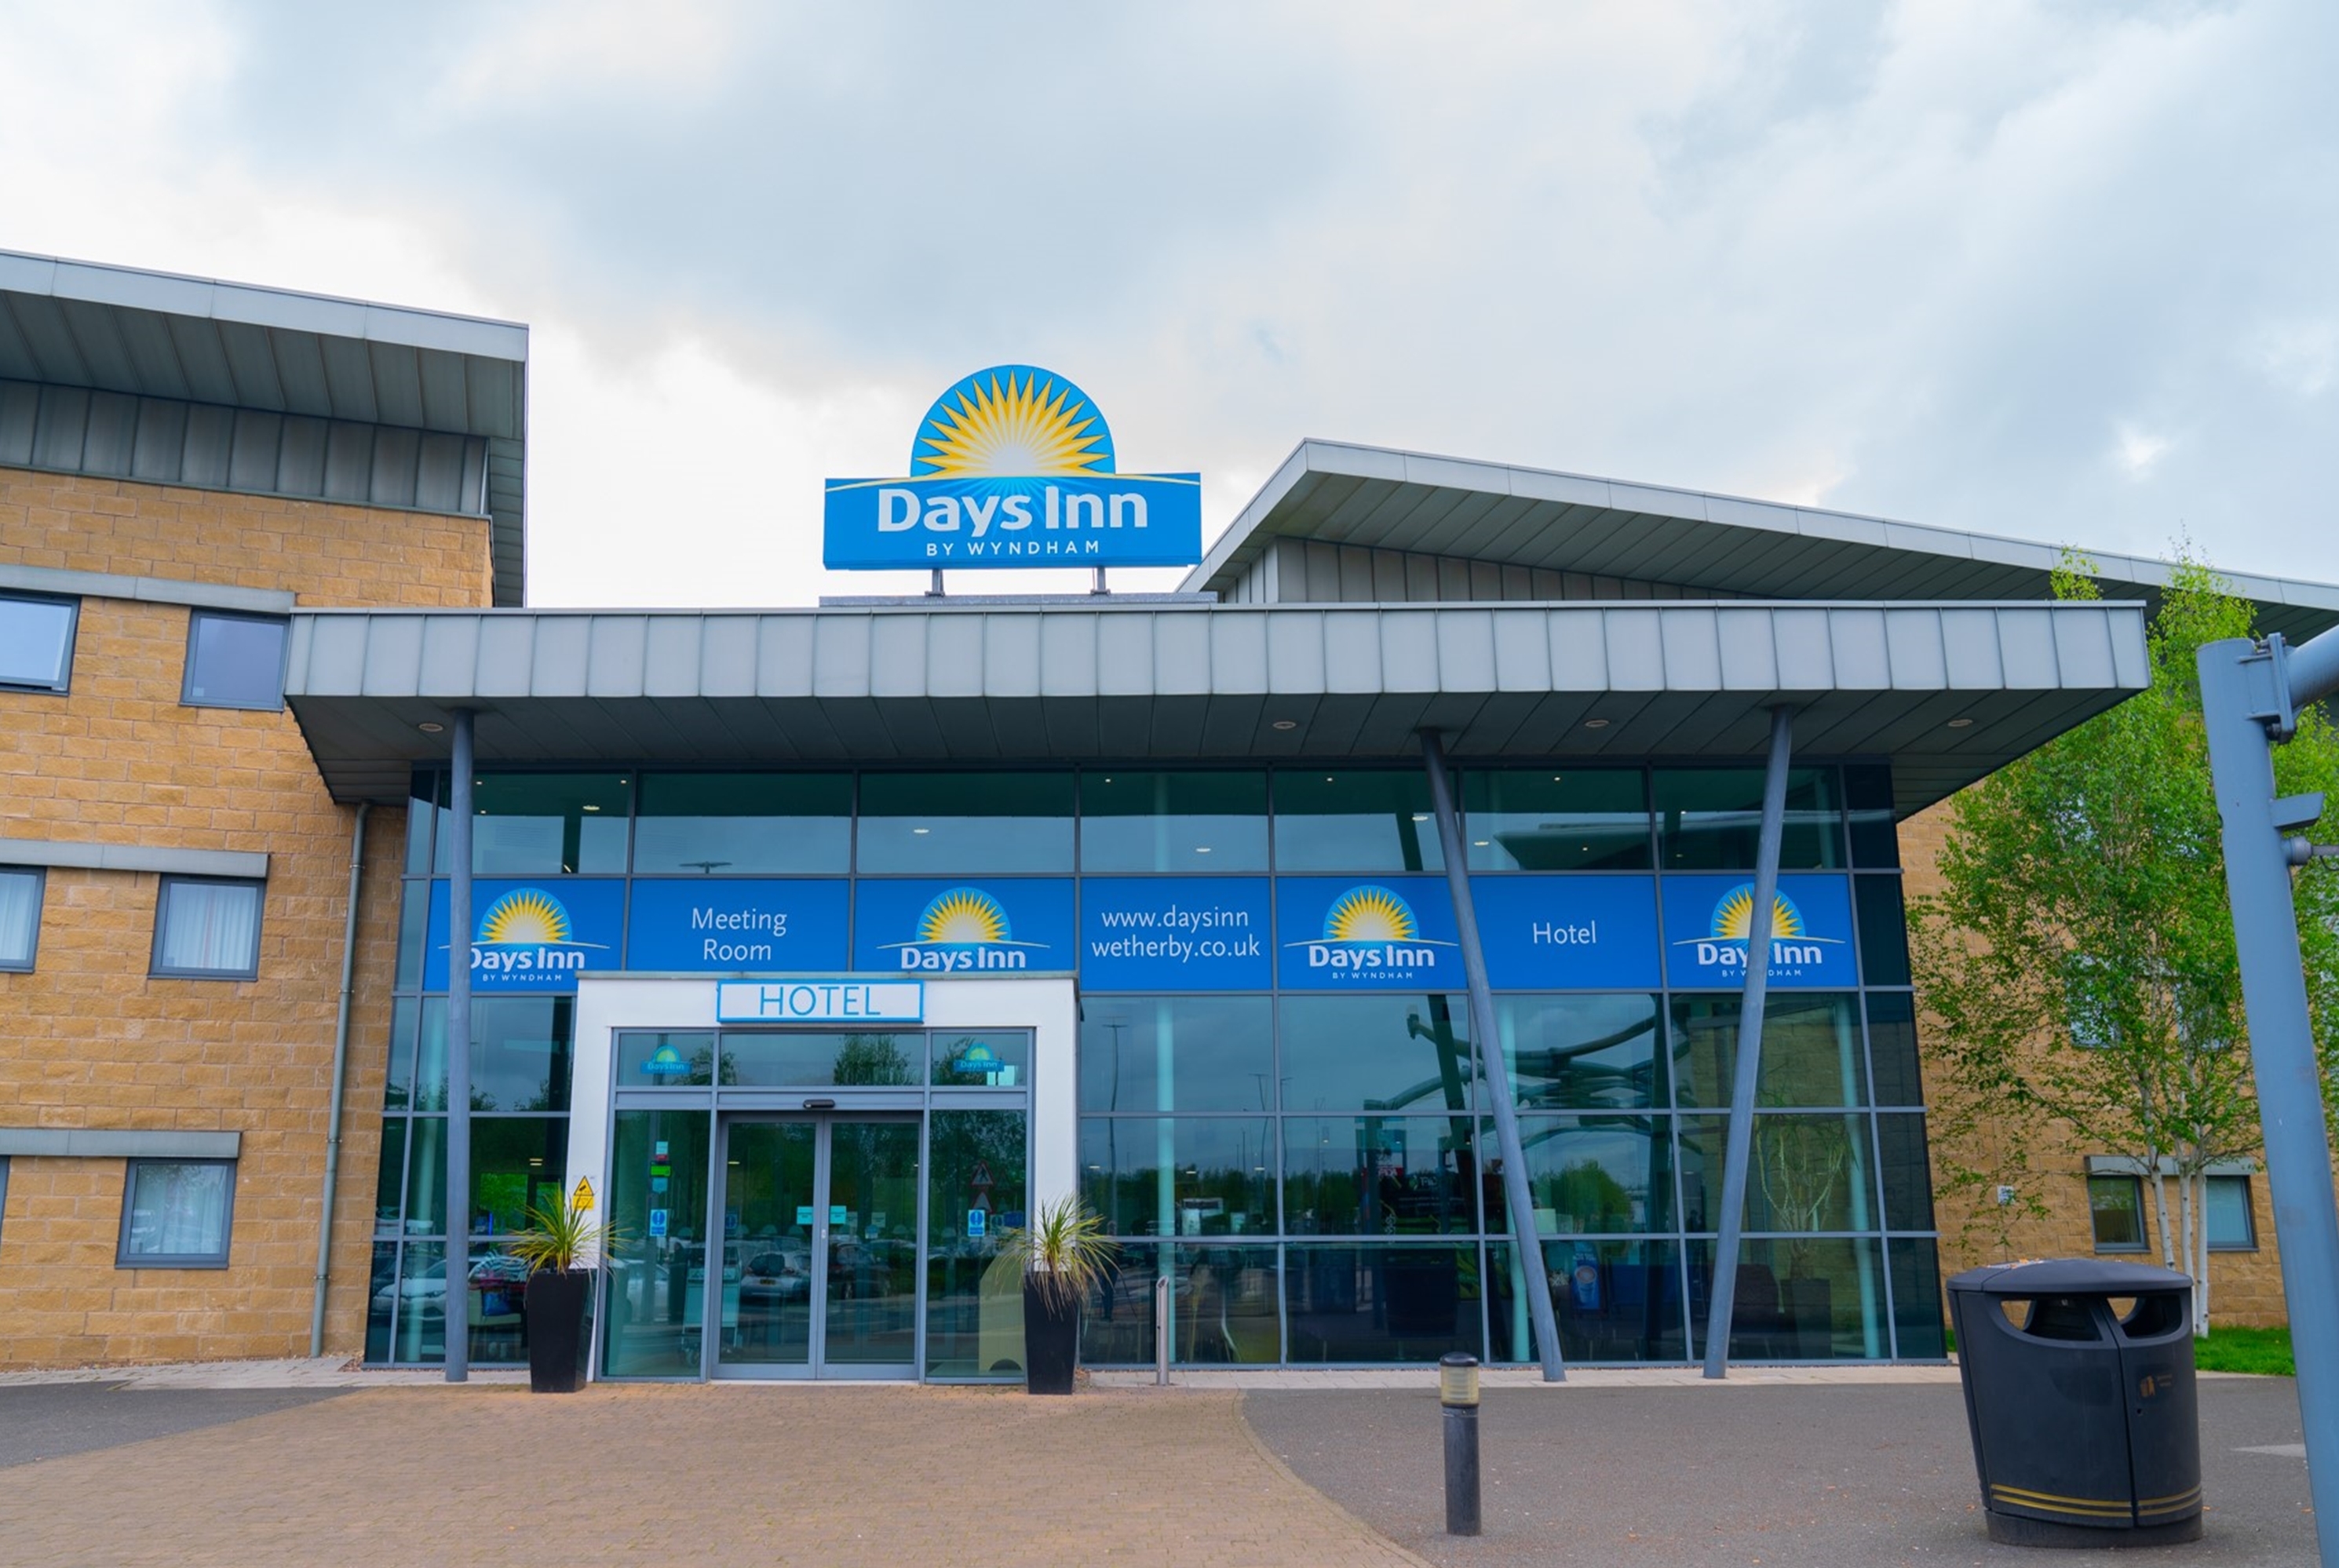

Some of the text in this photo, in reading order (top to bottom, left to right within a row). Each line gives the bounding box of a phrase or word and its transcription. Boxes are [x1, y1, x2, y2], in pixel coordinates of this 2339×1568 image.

[878, 485, 1148, 538] Days Inn
[926, 540, 1100, 556] BY WYNDHAM
[691, 907, 787, 936] Meeting
[1101, 904, 1249, 933] www.daysinn
[1533, 920, 1596, 945] Hotel
[538, 947, 585, 969] Inn
[703, 939, 772, 961] Room
[900, 946, 1026, 972] Days Inn
[1091, 933, 1260, 963] wetherby.co.uk
[1308, 944, 1435, 971] Days Inn
[1697, 942, 1823, 968] Day Inn
[482, 973, 562, 982] BY WYNDHAM
[759, 986, 881, 1016] HOTEL
